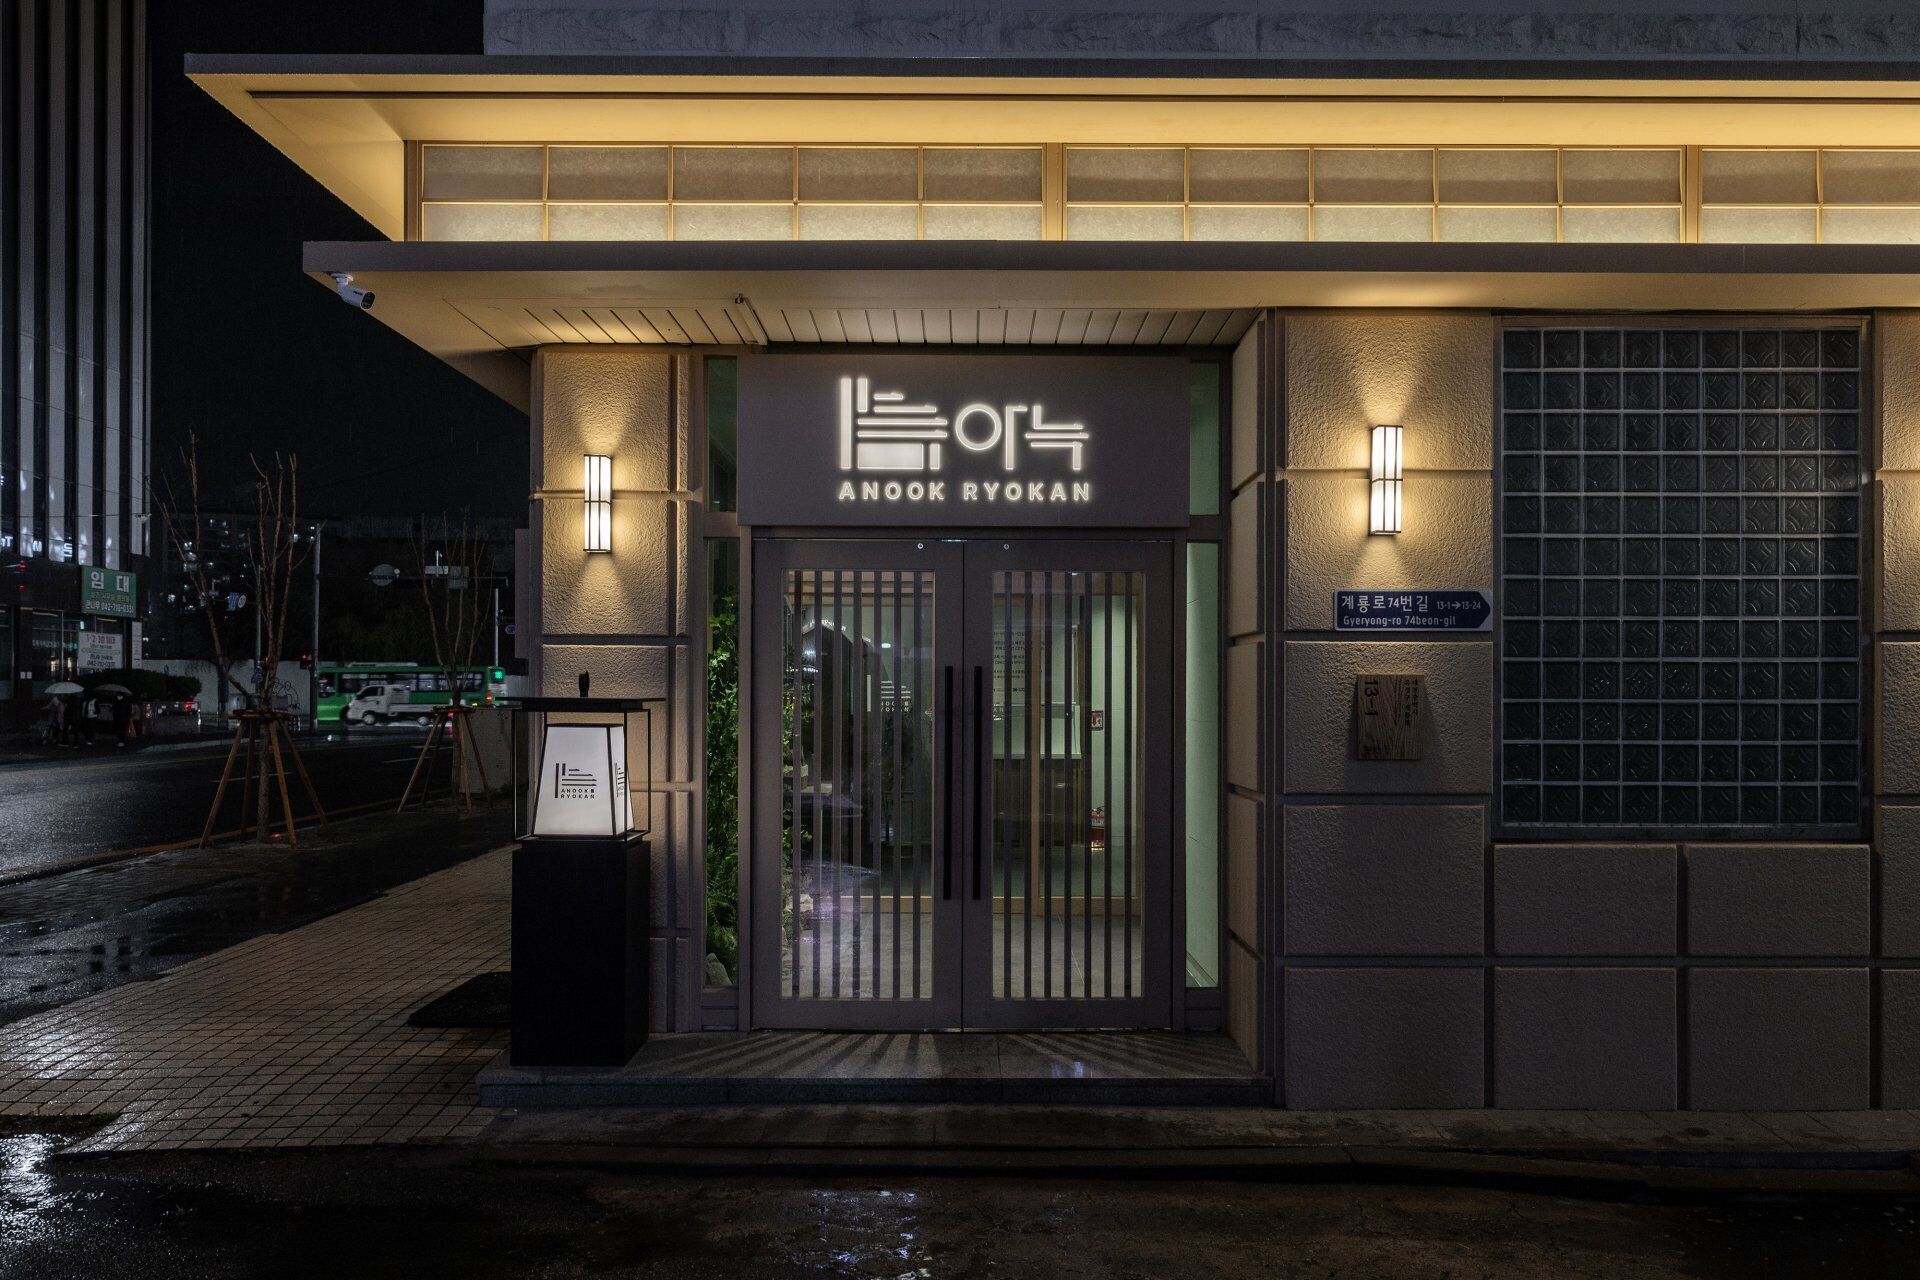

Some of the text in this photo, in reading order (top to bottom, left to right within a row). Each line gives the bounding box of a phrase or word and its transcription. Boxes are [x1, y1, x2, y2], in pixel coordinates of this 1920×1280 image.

[838, 481, 1090, 500] ANOOK RYOKAN
[1341, 595, 1429, 613] 계룡로74번길
[1343, 615, 1456, 627] Gyeryong-ro 74beon-gil
